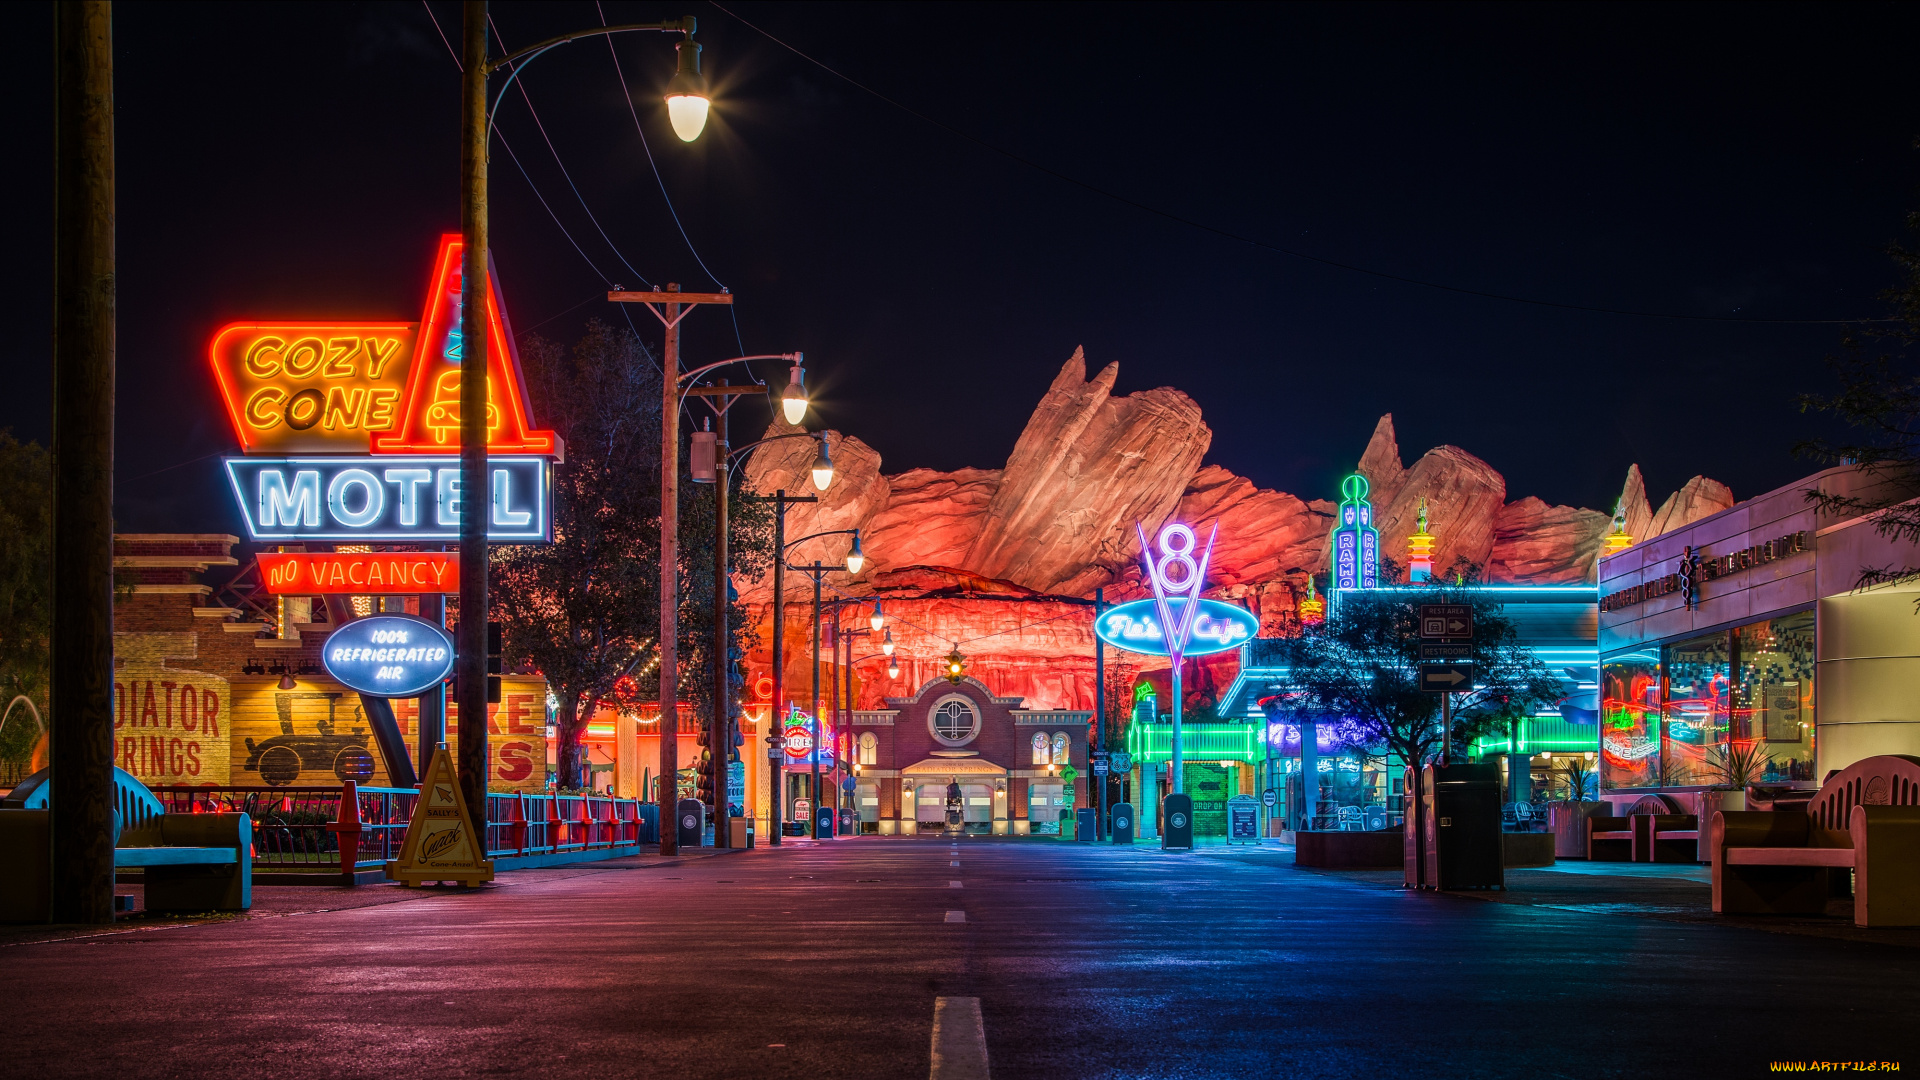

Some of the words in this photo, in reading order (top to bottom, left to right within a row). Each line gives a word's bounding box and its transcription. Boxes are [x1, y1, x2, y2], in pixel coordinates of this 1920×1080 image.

[246, 336, 399, 378] COZY
[246, 386, 399, 430] CONE
[259, 469, 531, 527] MOTEL
[270, 560, 298, 586] NO
[310, 561, 447, 586] VACANCY
[1107, 615, 1161, 638] Flo's
[371, 630, 408, 644] 100%
[332, 648, 446, 662] REFRIGERATED
[376, 666, 404, 679] AIR
[427, 809, 459, 817] SALLY'S
[796, 811, 808, 819] SALE
[1193, 802, 1212, 810] DROP
[418, 821, 461, 864] Snack
